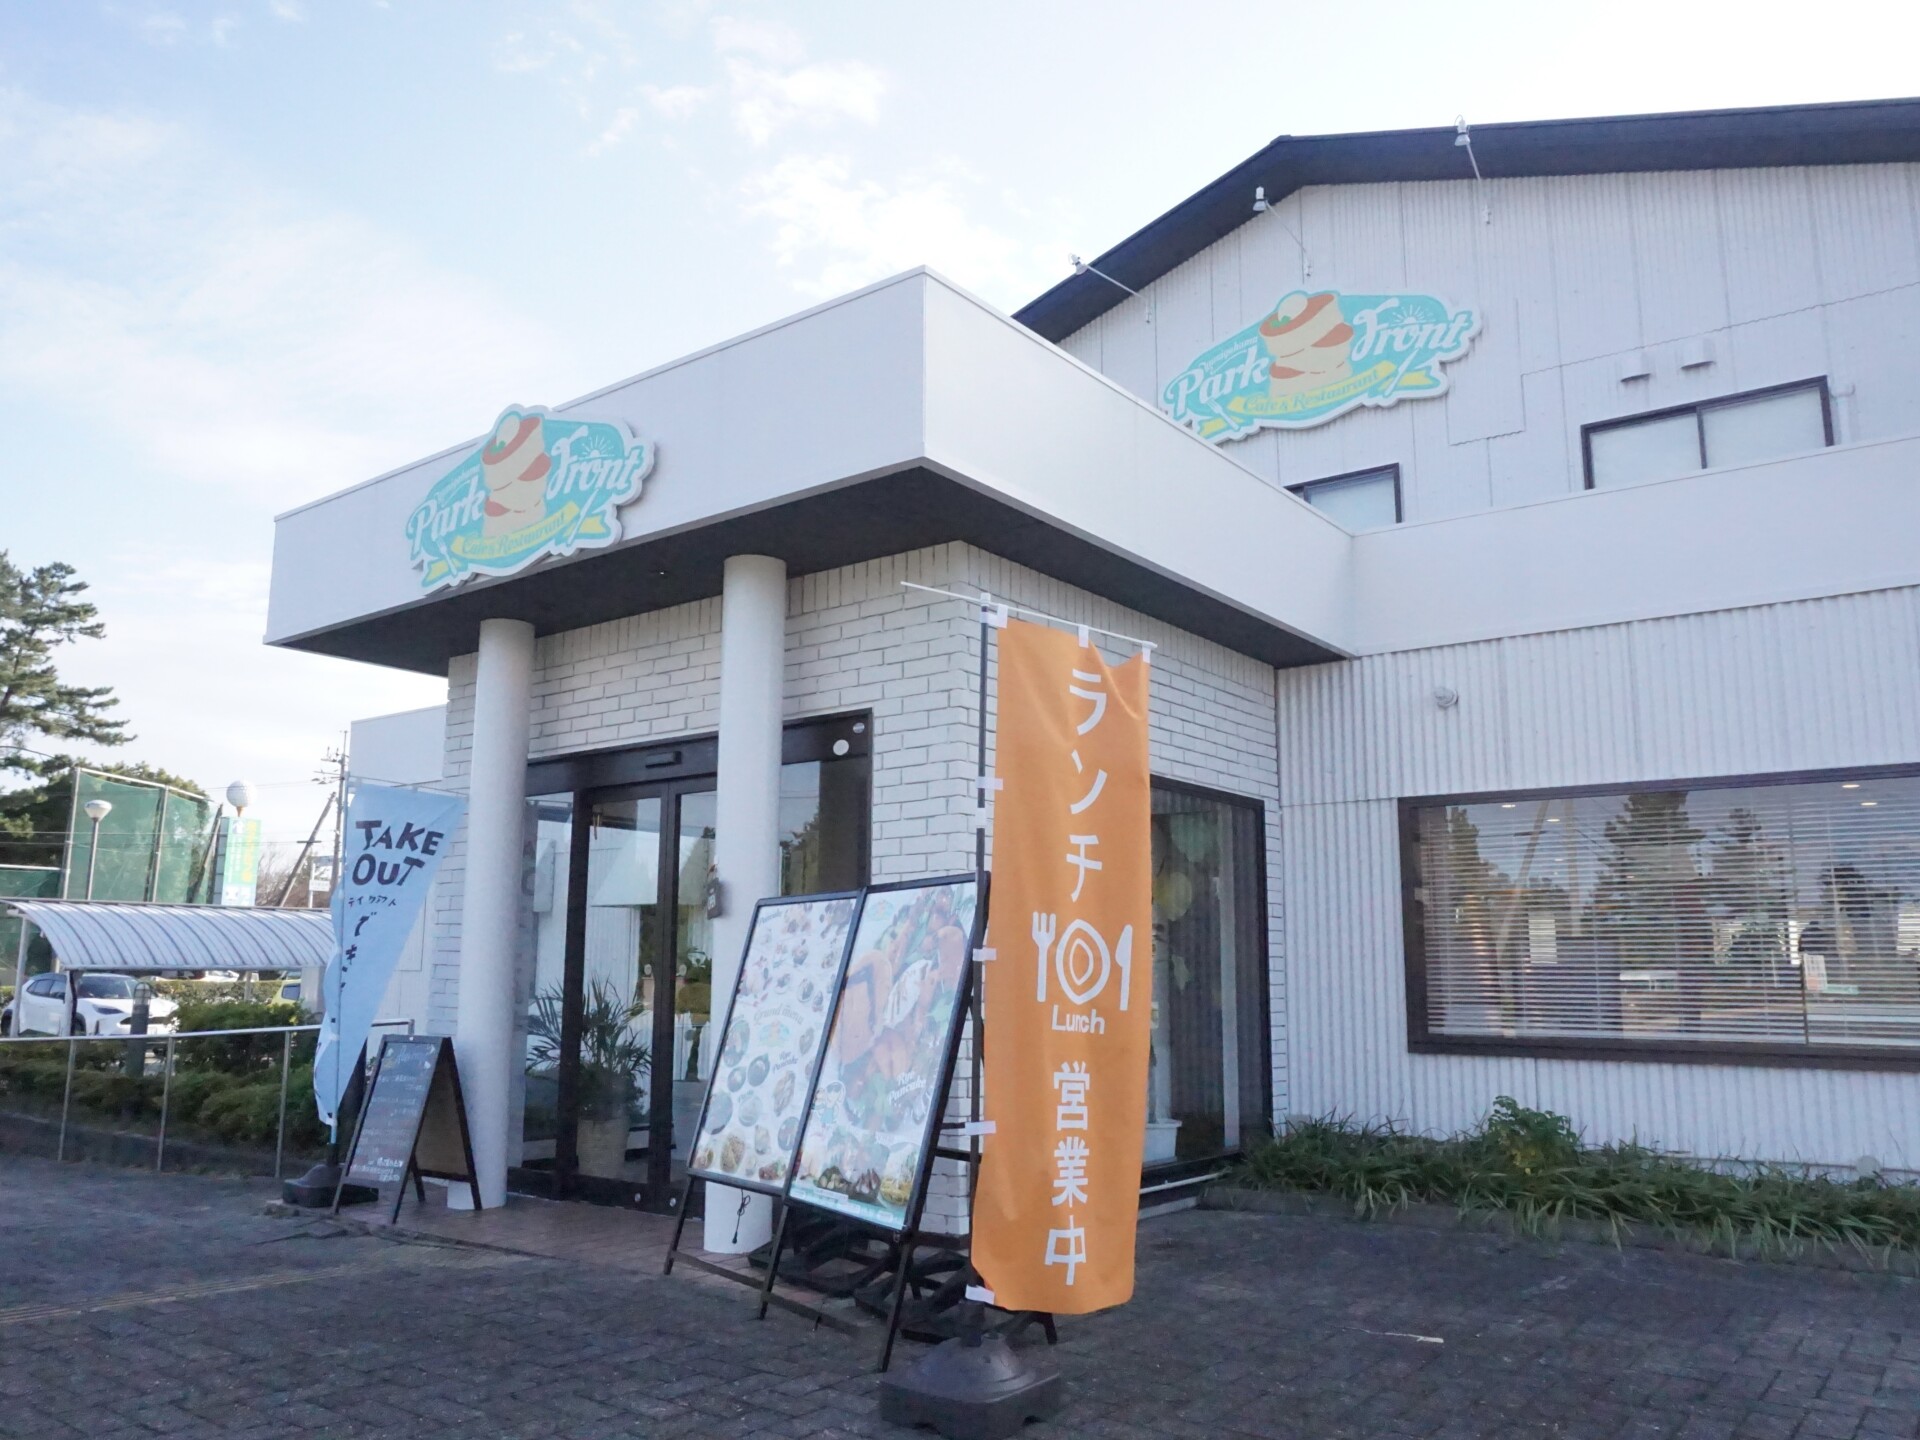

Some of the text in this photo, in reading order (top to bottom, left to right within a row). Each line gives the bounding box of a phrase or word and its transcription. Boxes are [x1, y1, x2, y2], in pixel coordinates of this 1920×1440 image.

[1169, 298, 1472, 415] Park Front
[1293, 371, 1379, 412] Restaurant
[407, 476, 486, 557] Park
[546, 425, 644, 499] Front
[1068, 668, 1108, 902] ランチ
[355, 820, 444, 856] TAKE
[352, 853, 425, 886] OUT
[1052, 1004, 1105, 1034] Lunch
[888, 1076, 926, 1105] Pancake
[1045, 1061, 1091, 1286] 営業中
